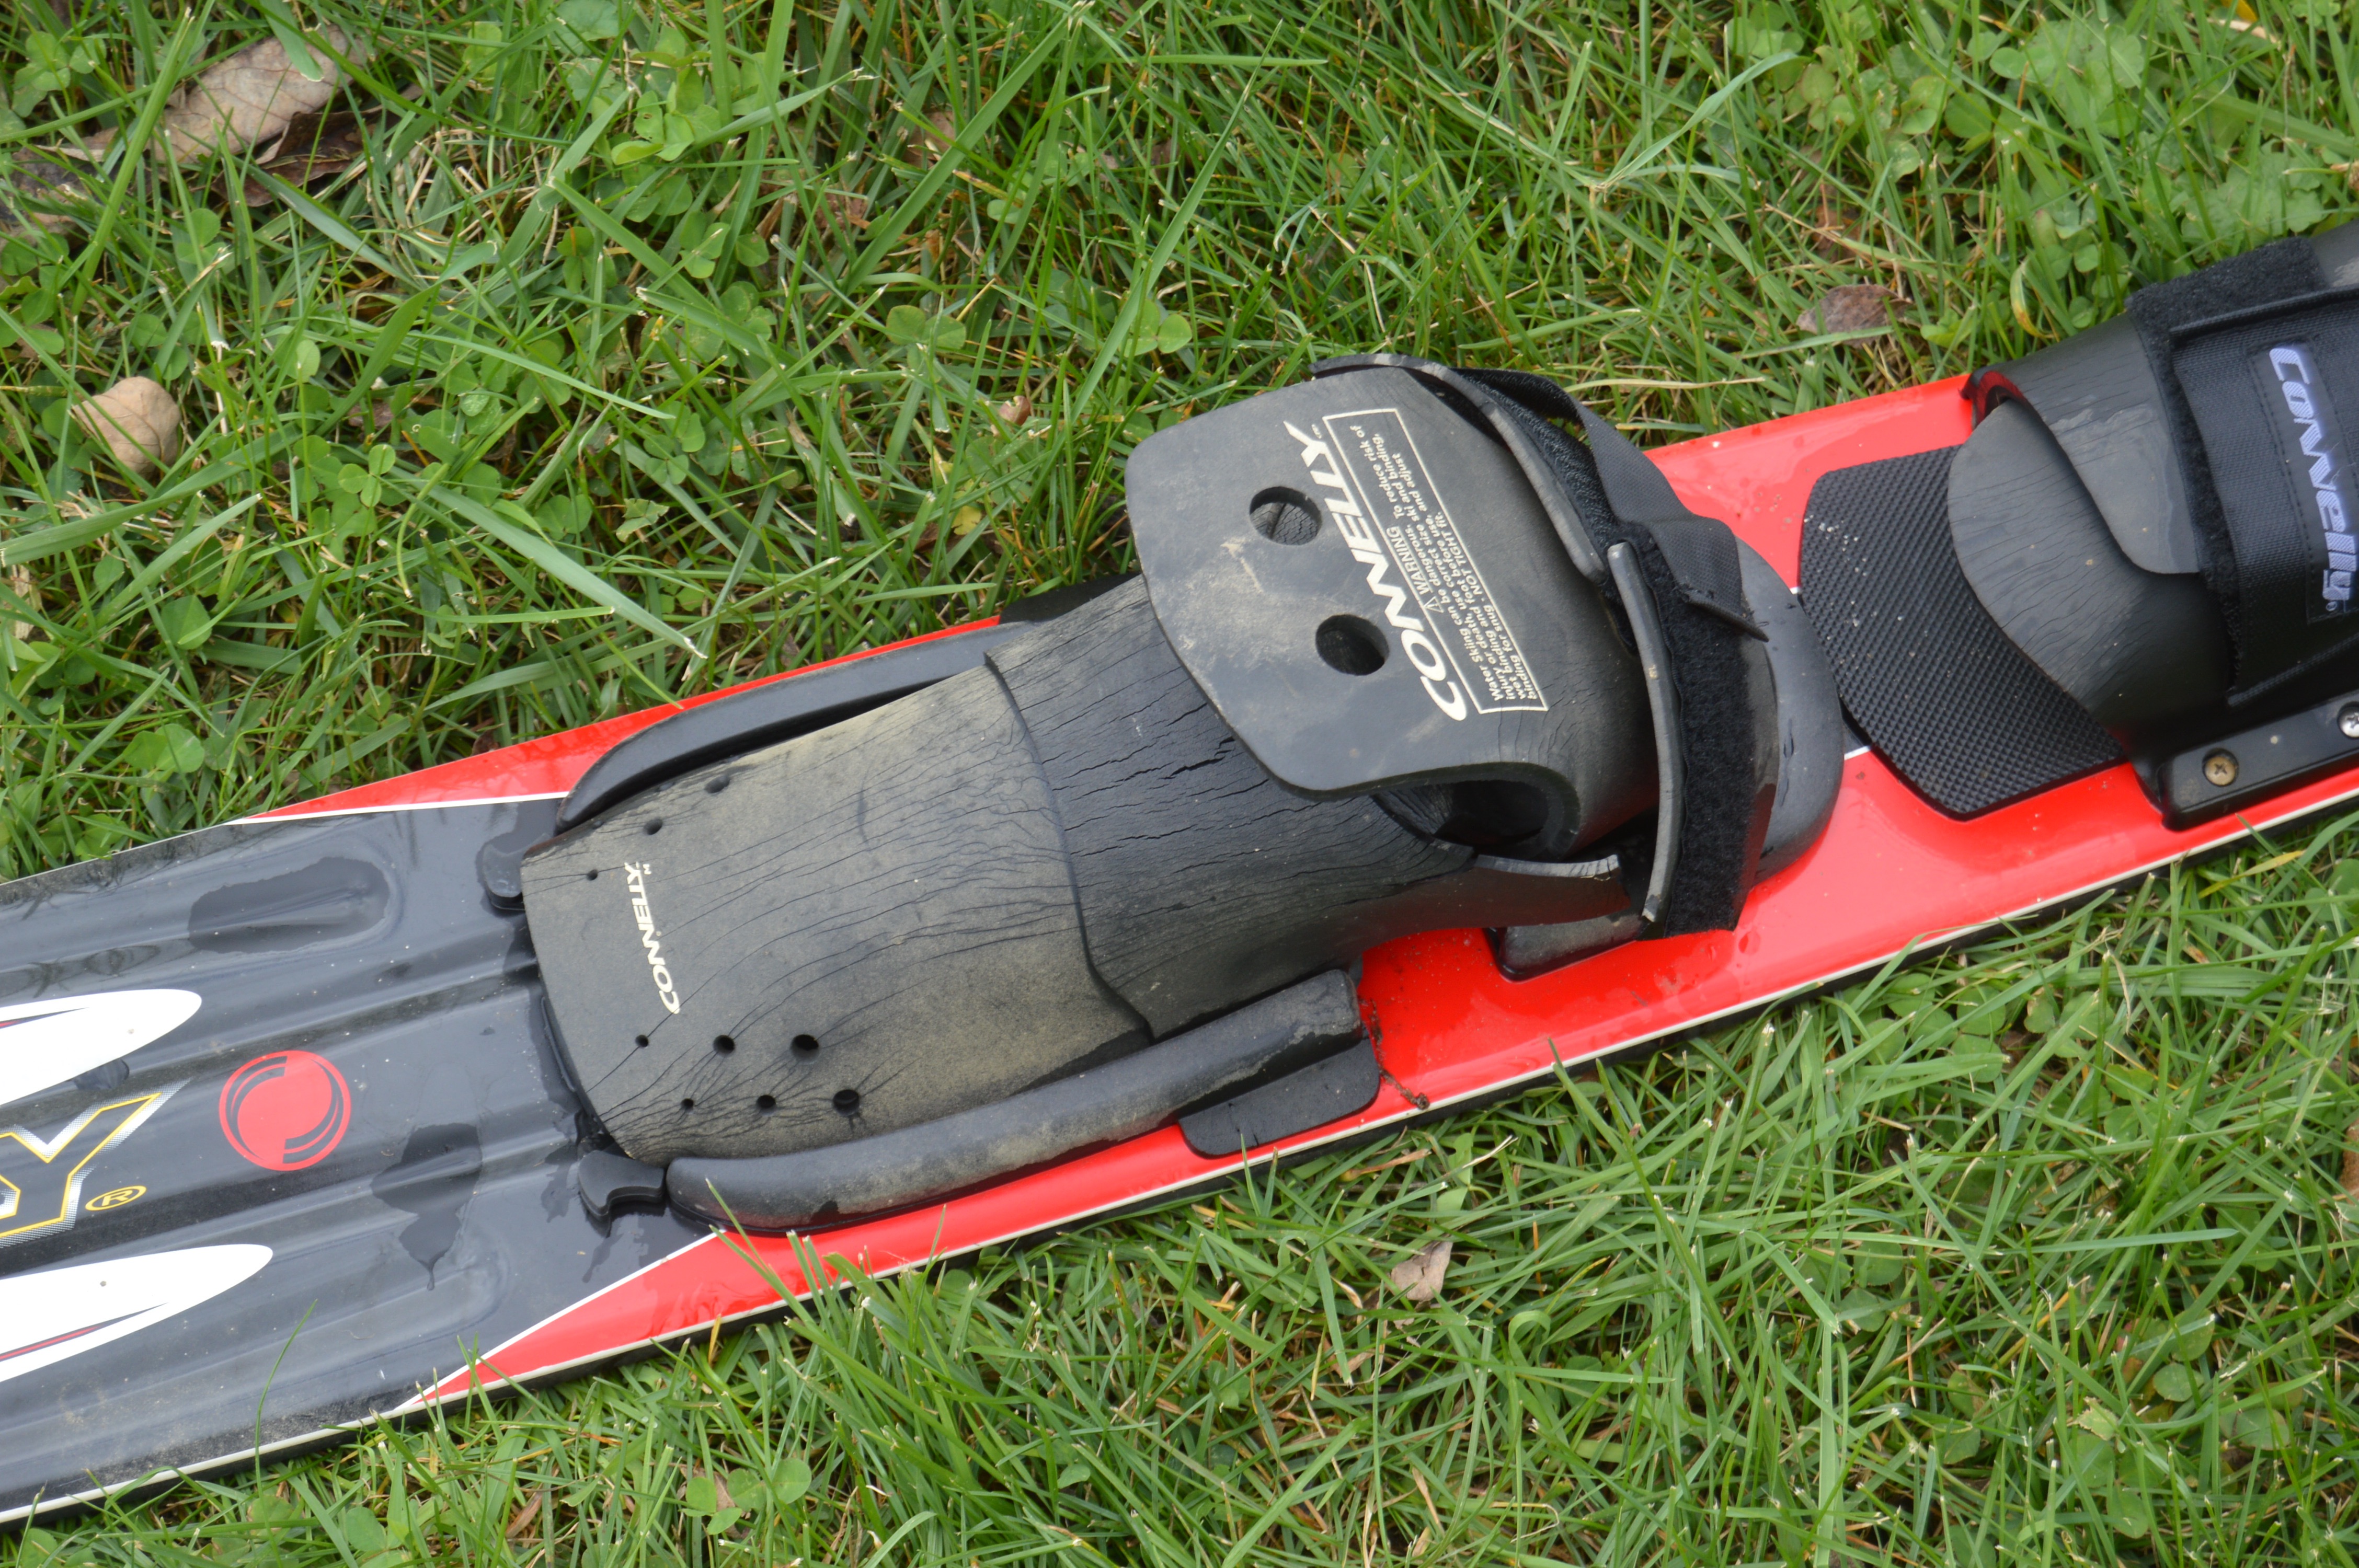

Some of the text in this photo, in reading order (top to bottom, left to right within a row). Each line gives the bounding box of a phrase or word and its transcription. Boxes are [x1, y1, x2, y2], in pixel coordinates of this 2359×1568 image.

[1434, 512, 1447, 528] fit.
[1284, 421, 1467, 721] CONNELLY
[1349, 425, 1504, 701] Water Skiing can be dangerous. To reduce risk of
[1372, 433, 1516, 700] injury or death, use correct size ski and binding,
[1386, 526, 1432, 595] WARNING
[1392, 453, 1527, 700] wet binding and foot before use, and adjust
[1440, 531, 1467, 567] TIGHT
[1461, 569, 1483, 595] NOT
[1483, 605, 1503, 632] snug
[1498, 635, 1513, 652] for
[1509, 654, 1538, 699] binding
[624, 862, 680, 1014] CONNELLY
